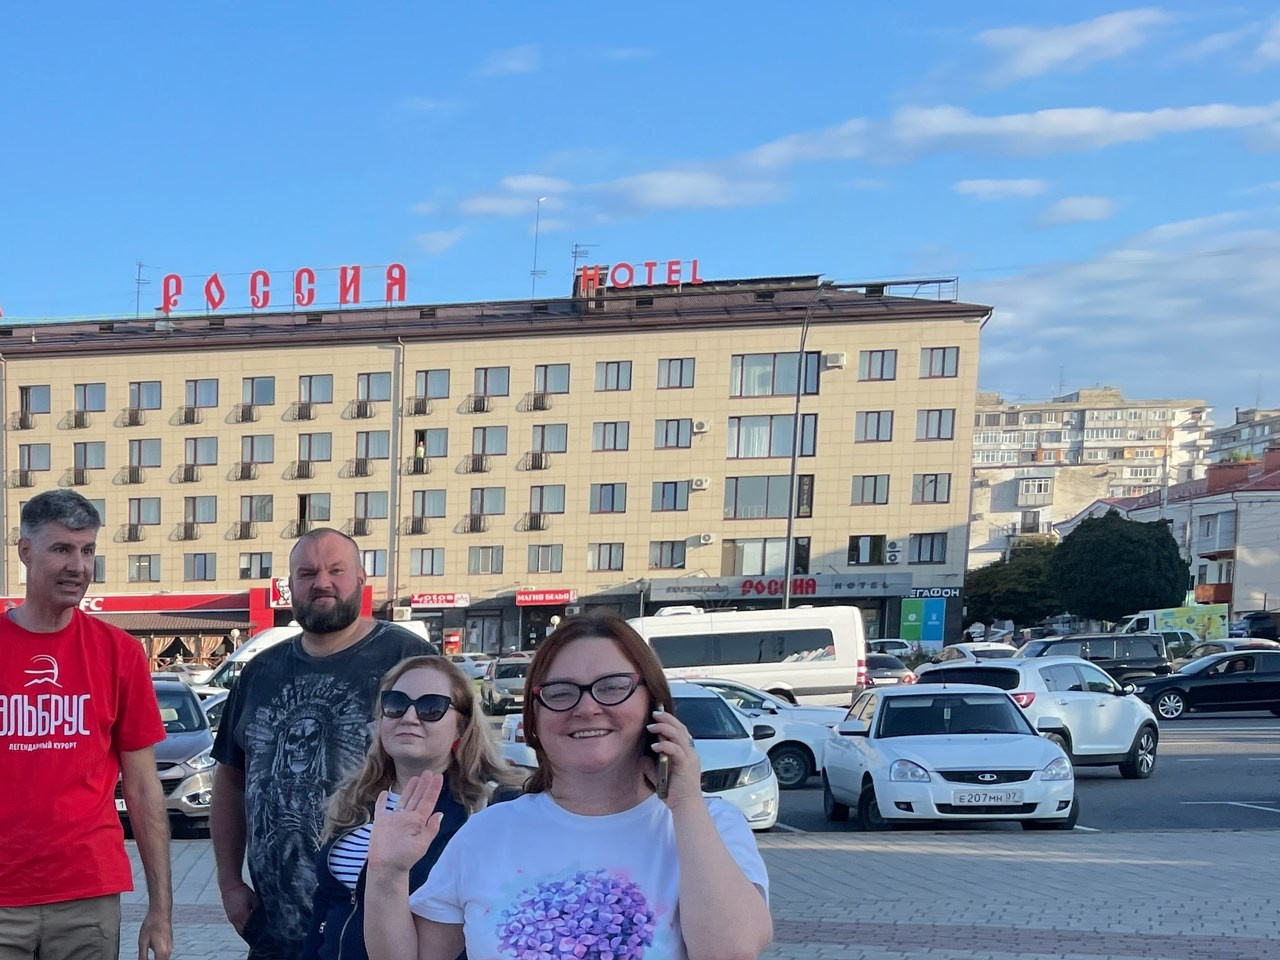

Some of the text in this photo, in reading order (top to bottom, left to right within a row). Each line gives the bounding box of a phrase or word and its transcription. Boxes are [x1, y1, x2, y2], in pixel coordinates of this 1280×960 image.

[581, 259, 703, 289] HOTEL
[163, 263, 407, 313] РОССИЯ
[834, 582, 889, 590] HOTEL
[902, 588, 960, 598] ЕГАФОН
[79, 597, 104, 610] FC
[9, 741, 77, 752] ЛЕГЕНДАРНЫЙ КУРОРТ
